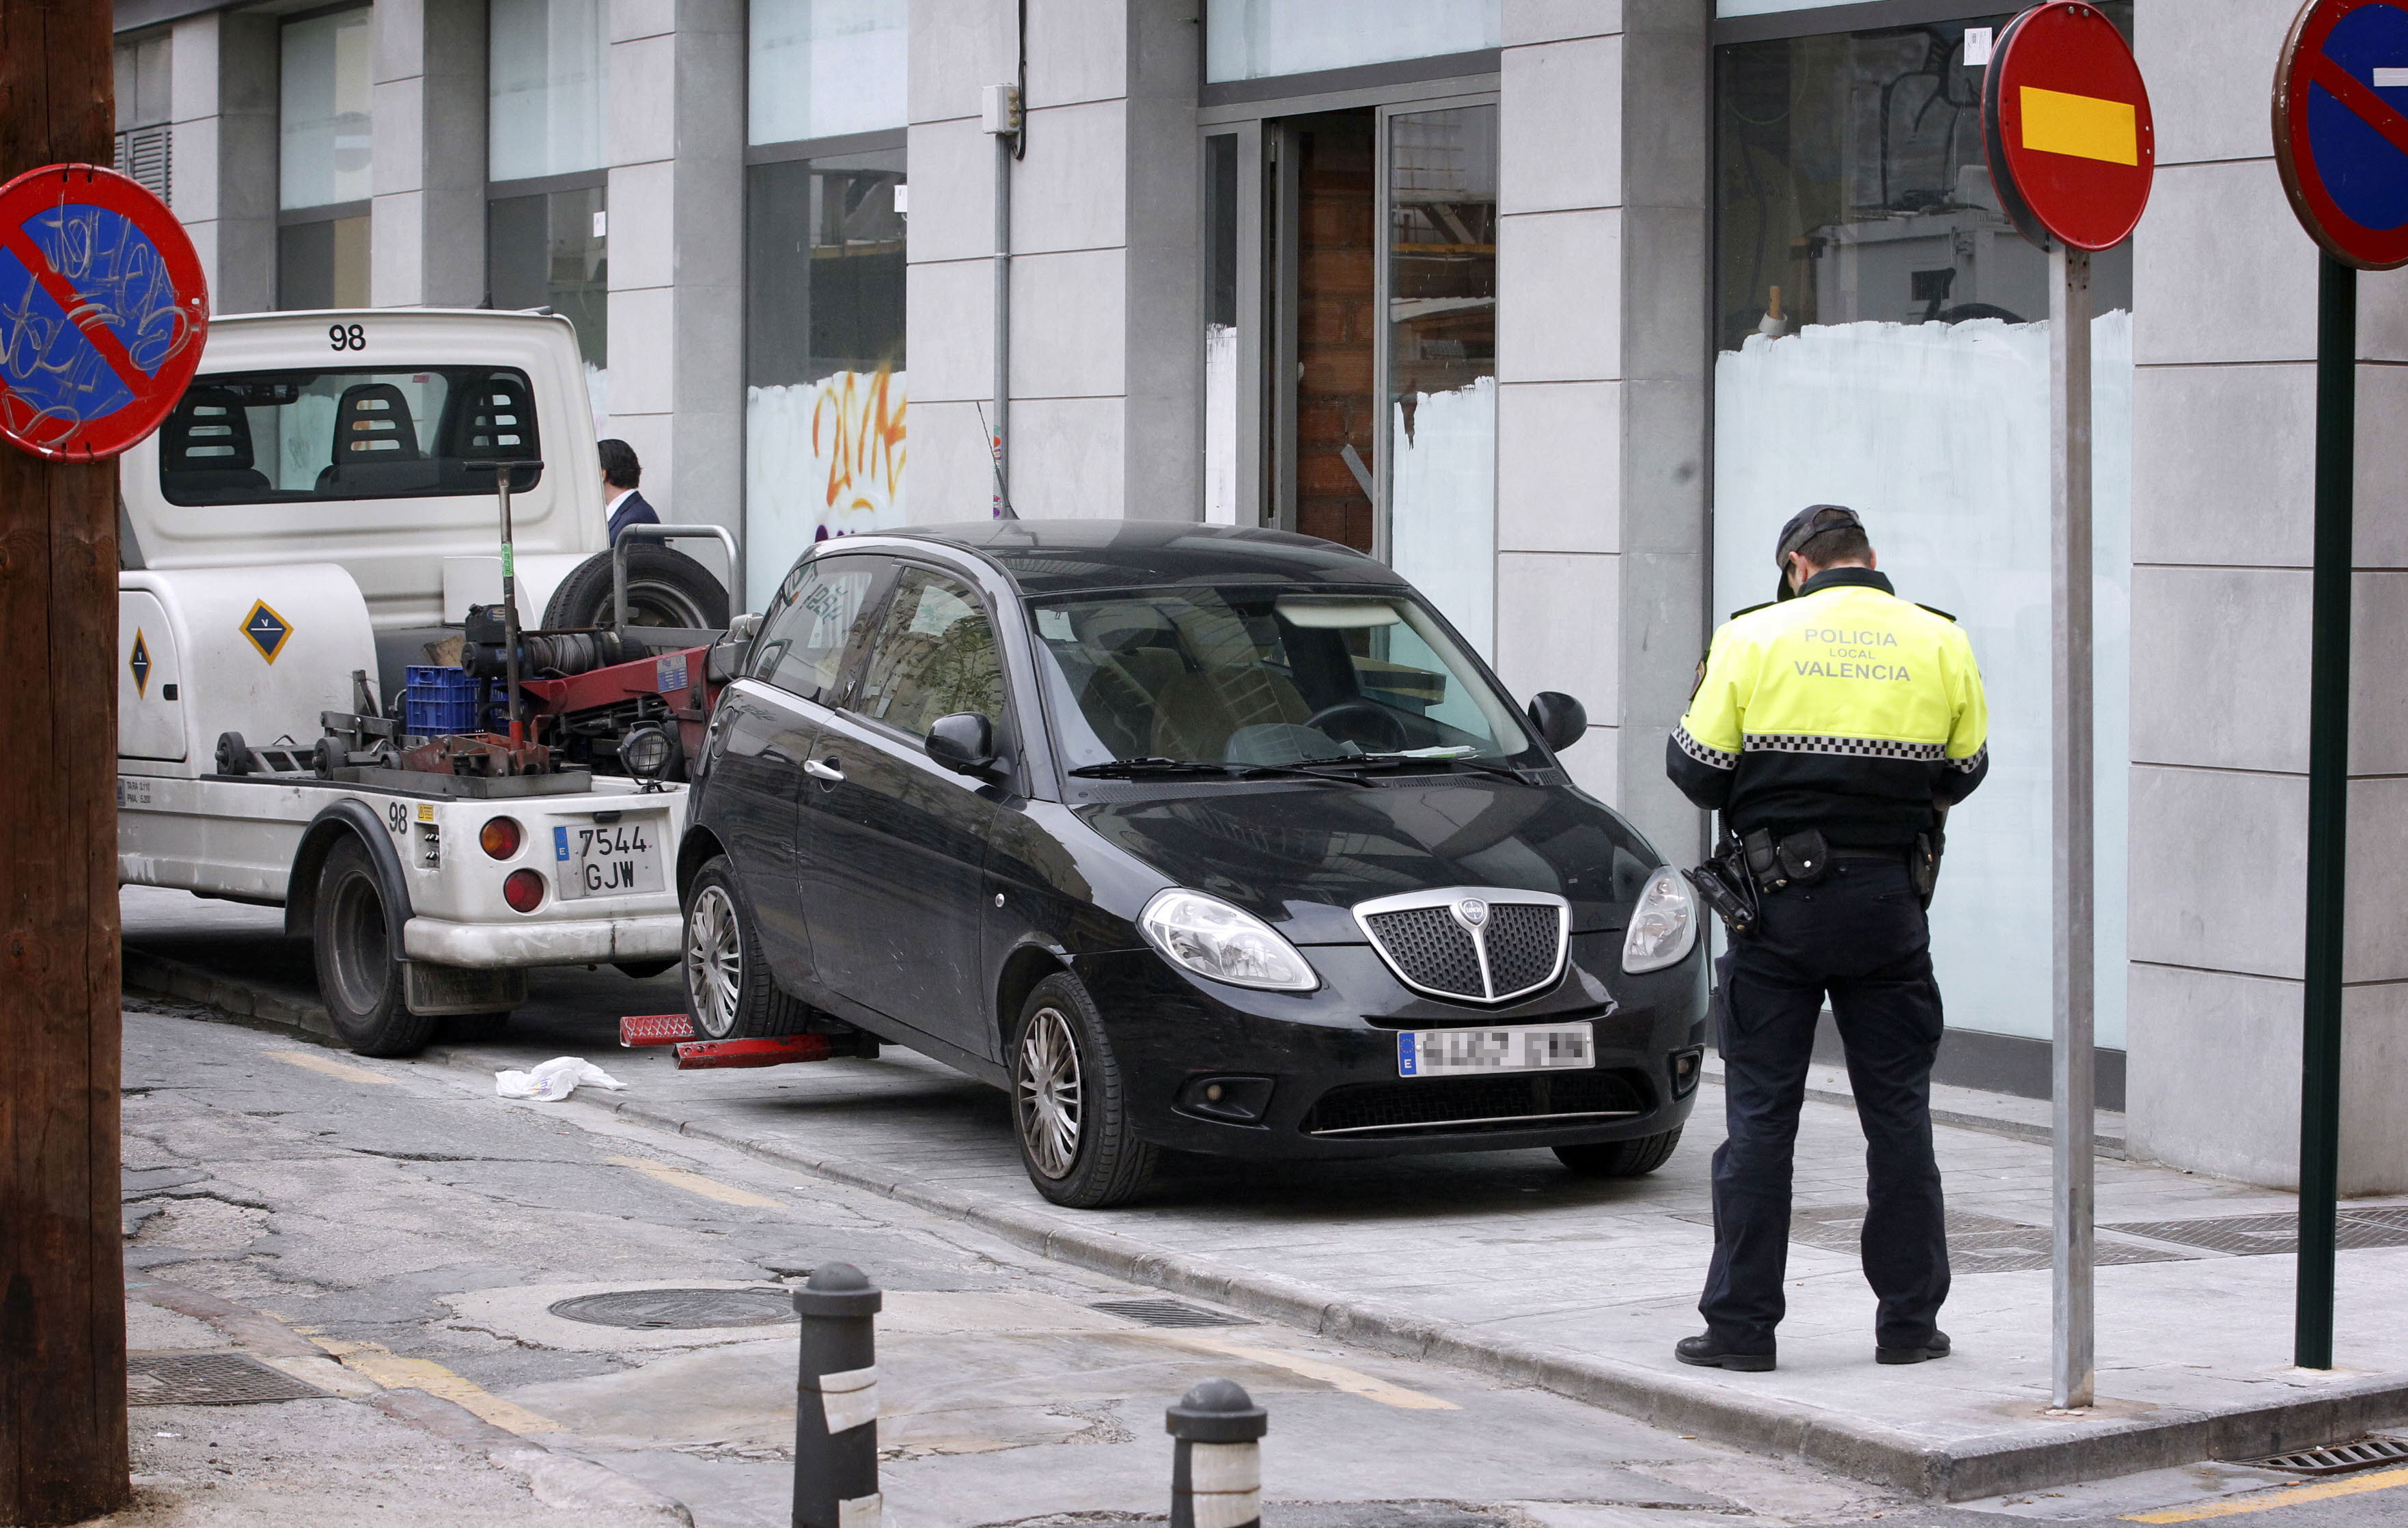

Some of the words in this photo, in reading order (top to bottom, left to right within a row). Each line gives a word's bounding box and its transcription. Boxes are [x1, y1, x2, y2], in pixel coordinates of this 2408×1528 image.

[329, 324, 366, 351] 98
[261, 619, 268, 627] V
[1805, 629, 1898, 646] POLICIA
[1829, 648, 1875, 659] LOCAL
[1794, 661, 1911, 682] VALENCIA
[389, 802, 407, 834] 98
[559, 847, 566, 855] E
[579, 826, 647, 857] 7544
[585, 861, 633, 890] GJW
[1404, 1059, 1412, 1068] E
